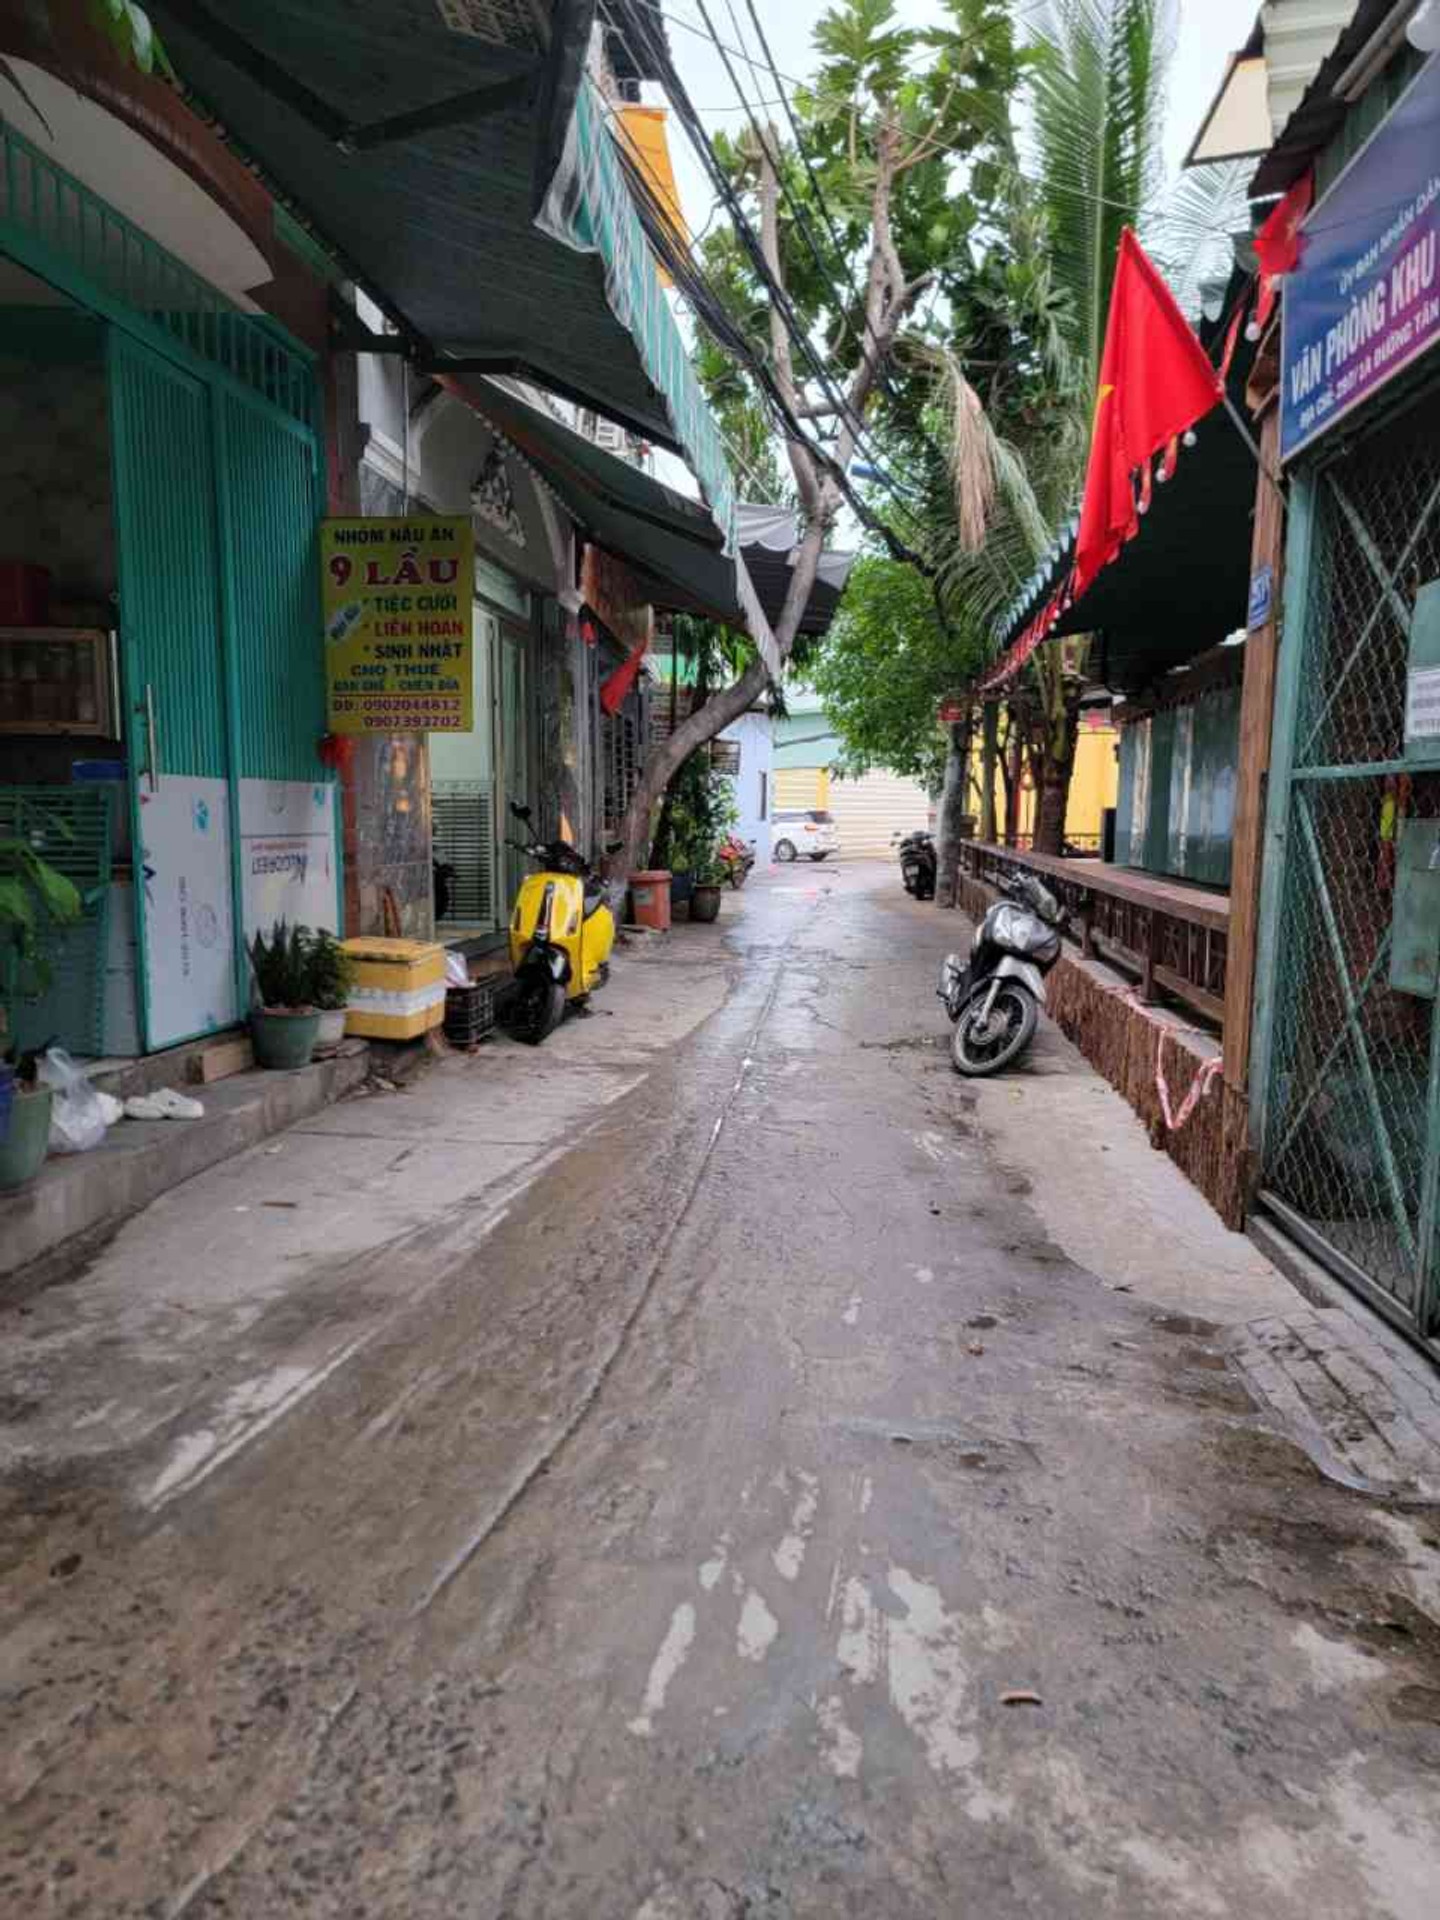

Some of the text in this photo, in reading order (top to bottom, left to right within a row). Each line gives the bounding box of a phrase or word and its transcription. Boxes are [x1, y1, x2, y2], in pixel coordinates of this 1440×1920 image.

[1291, 229, 1437, 405] VĂN PHÒNG KHU
[330, 555, 352, 587] 9
[374, 644, 412, 659] SINH
[351, 664, 387, 677] CHO
